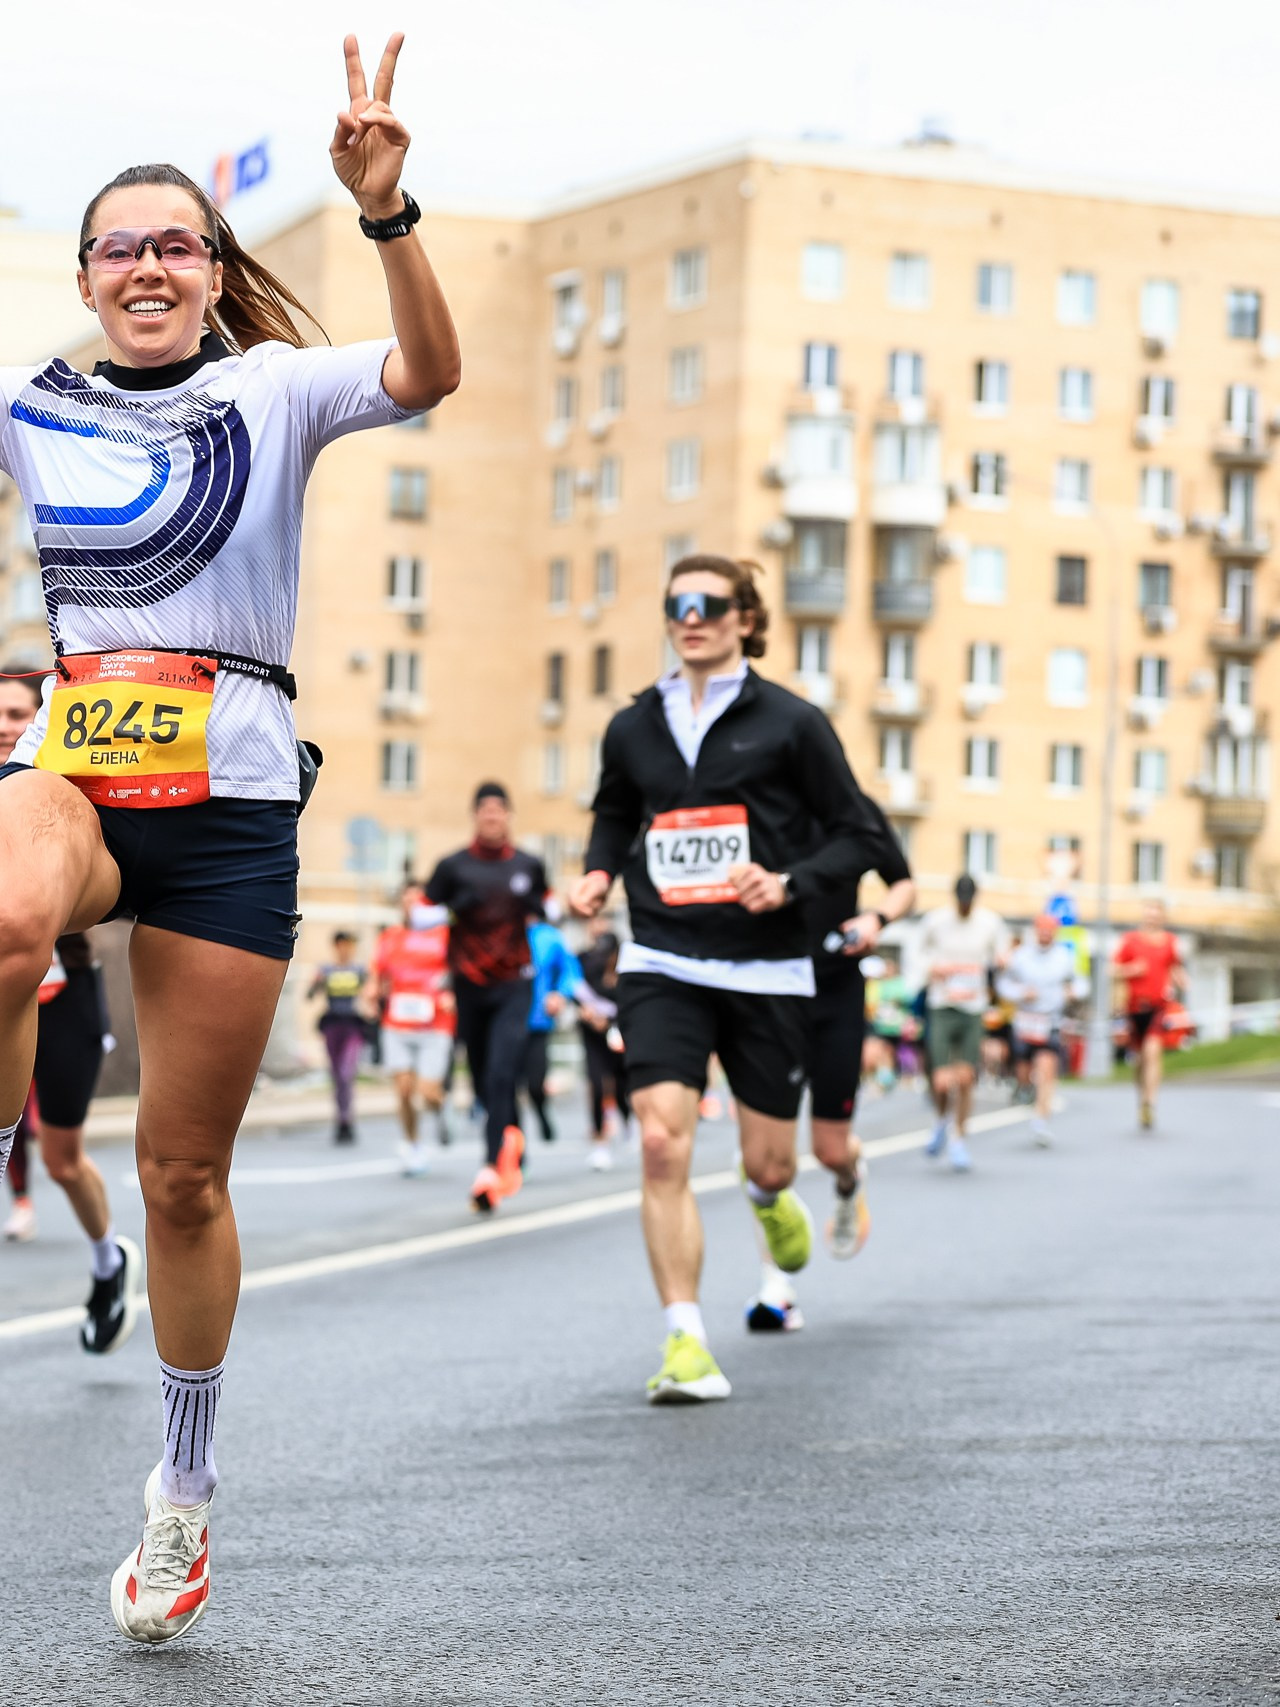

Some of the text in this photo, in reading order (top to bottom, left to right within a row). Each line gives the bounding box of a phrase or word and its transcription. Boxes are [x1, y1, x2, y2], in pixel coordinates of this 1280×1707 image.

[100, 654, 155, 665] МОСКОВСКИЙ
[98, 670, 136, 678] МАРАФОН
[63, 698, 184, 750] 8245
[90, 751, 140, 765] ЕЛЕНА
[655, 835, 742, 865] 14709
